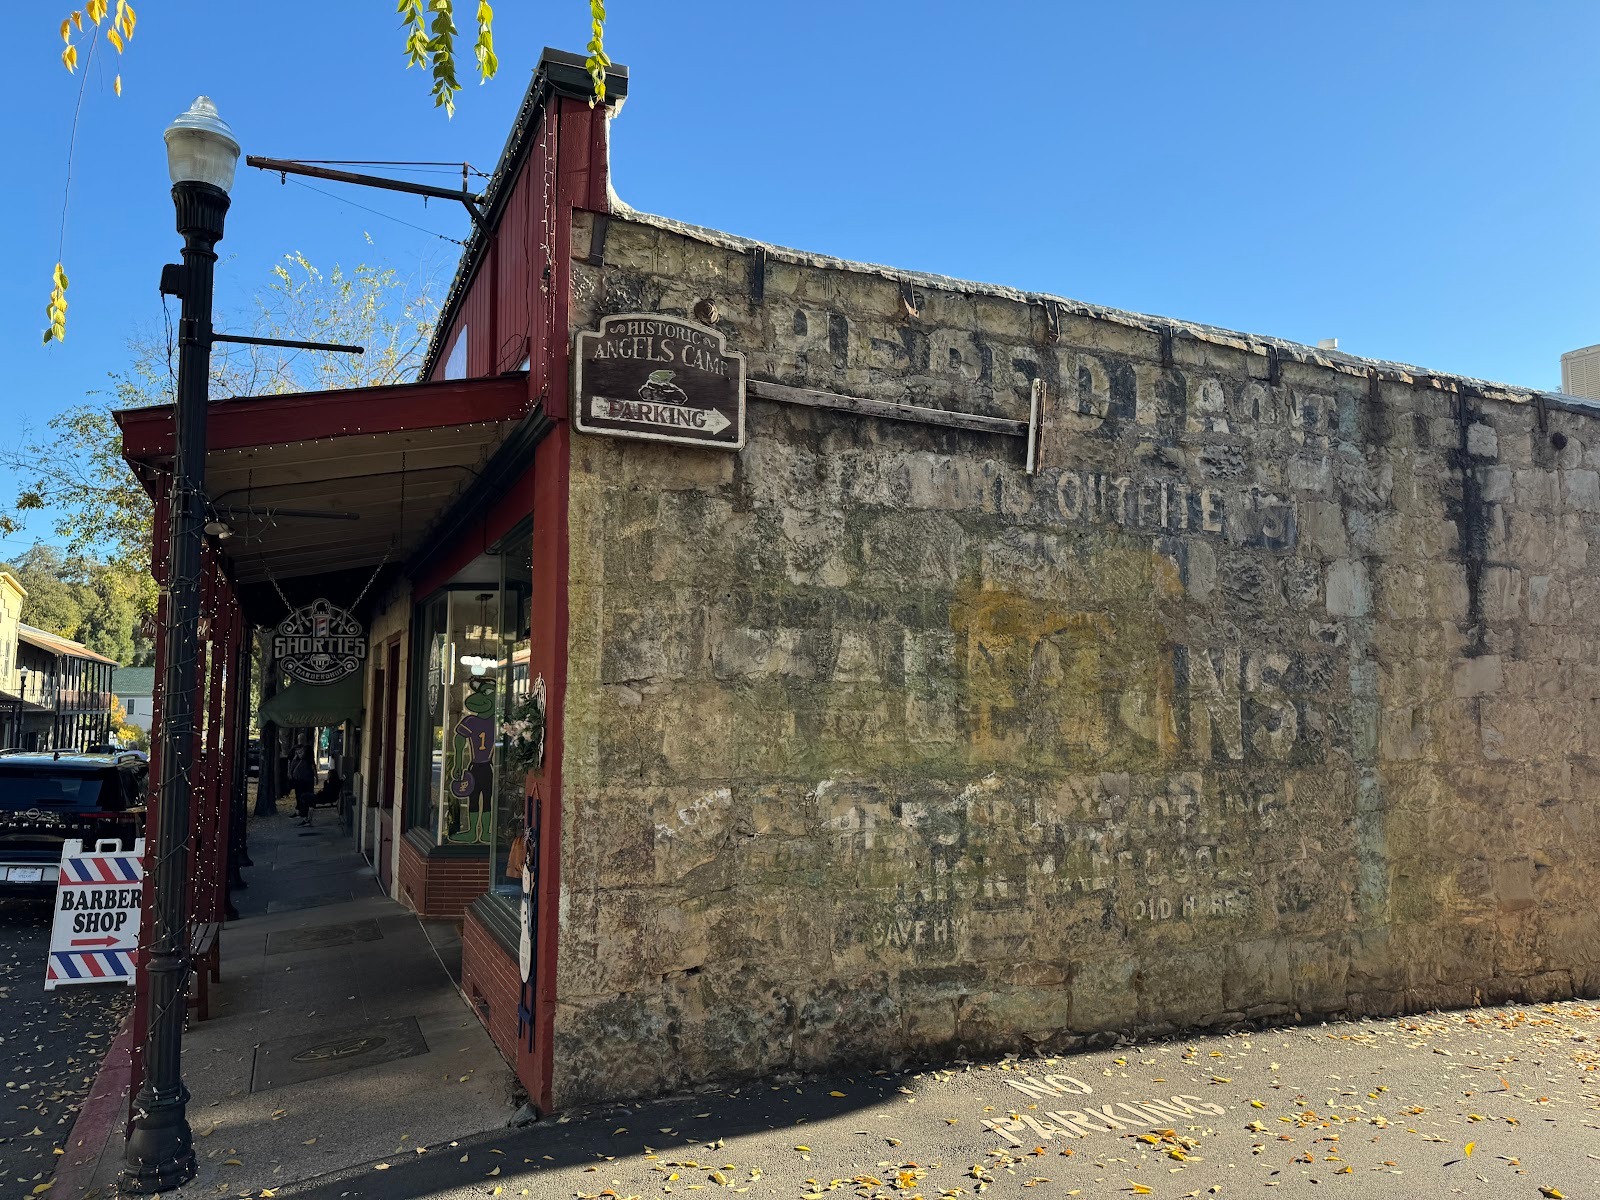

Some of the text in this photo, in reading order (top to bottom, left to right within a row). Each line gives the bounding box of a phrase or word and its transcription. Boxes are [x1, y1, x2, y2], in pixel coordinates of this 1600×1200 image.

[626, 321, 702, 346] HISTORIC
[594, 336, 731, 376] ANGELS CAMP
[608, 400, 708, 428] PARKING
[274, 637, 366, 659] SHORTIES
[479, 732, 487, 751] 1
[61, 889, 143, 911] BARBER
[72, 911, 128, 934] SHOP
[1003, 1073, 1094, 1100] NO
[979, 1094, 1226, 1148] PARKING
